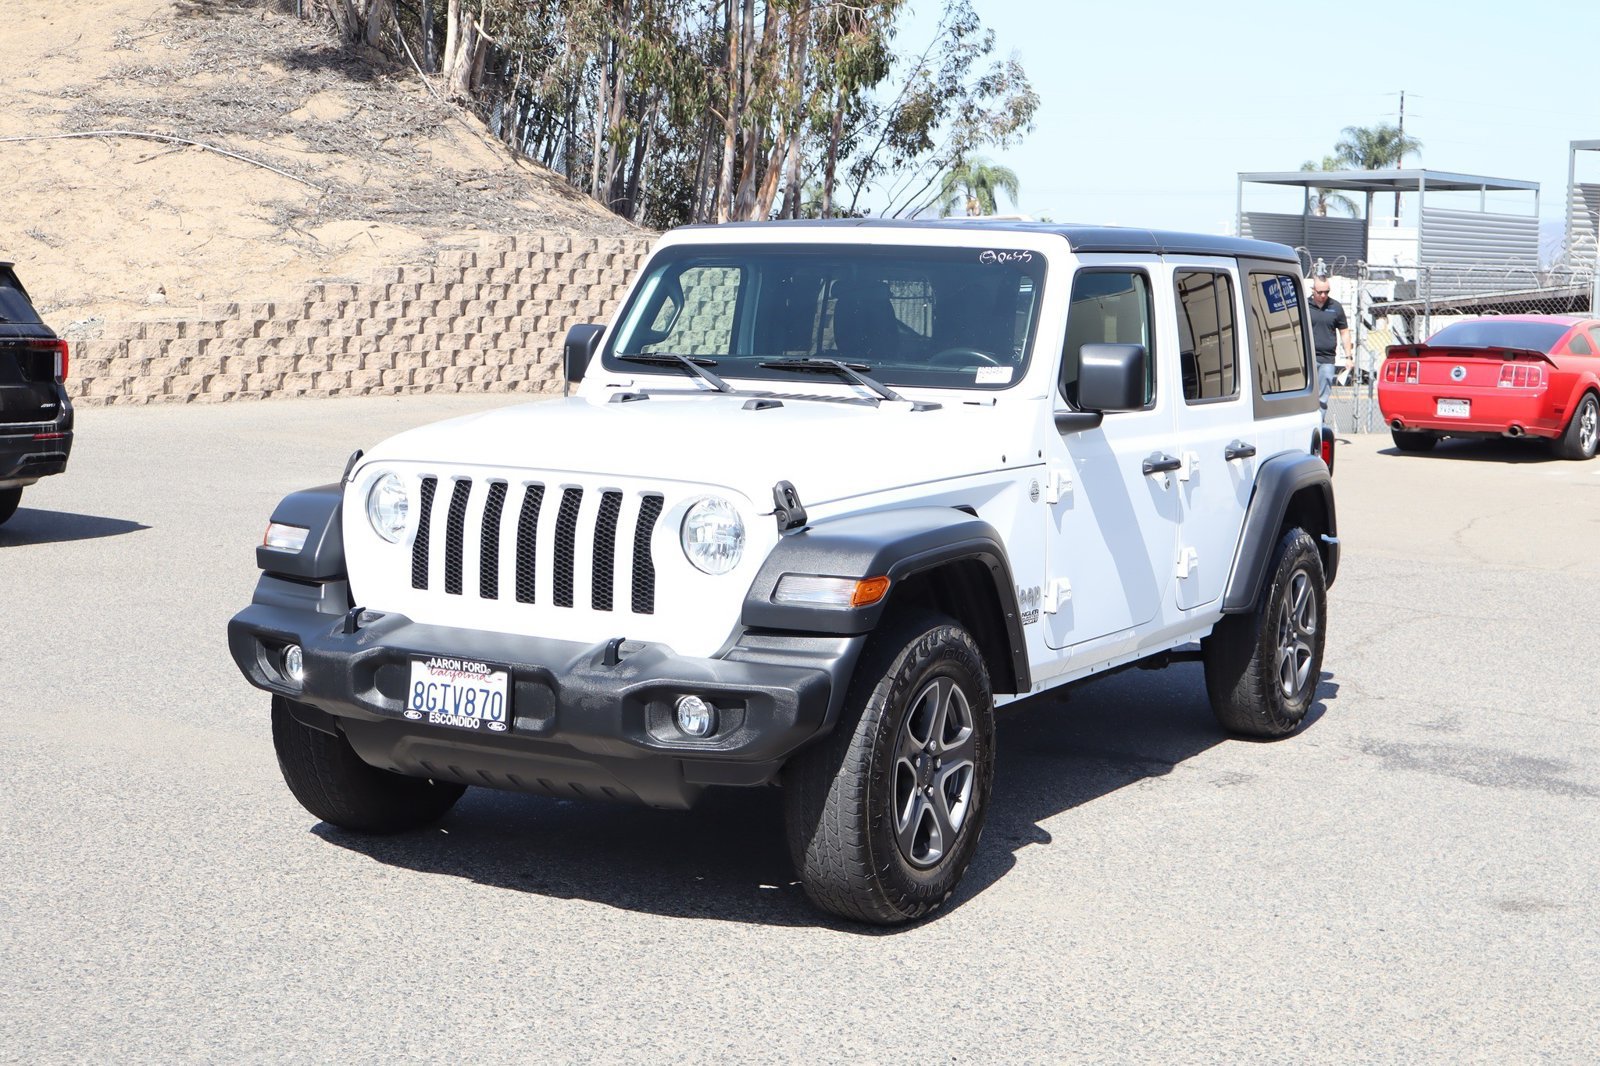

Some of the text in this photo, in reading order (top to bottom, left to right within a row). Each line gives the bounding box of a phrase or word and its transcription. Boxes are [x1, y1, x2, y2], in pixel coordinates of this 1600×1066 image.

[430, 657, 487, 674] AARON FORD
[412, 680, 503, 721] 8GIV870
[428, 711, 480, 729] ESCONDIDO
